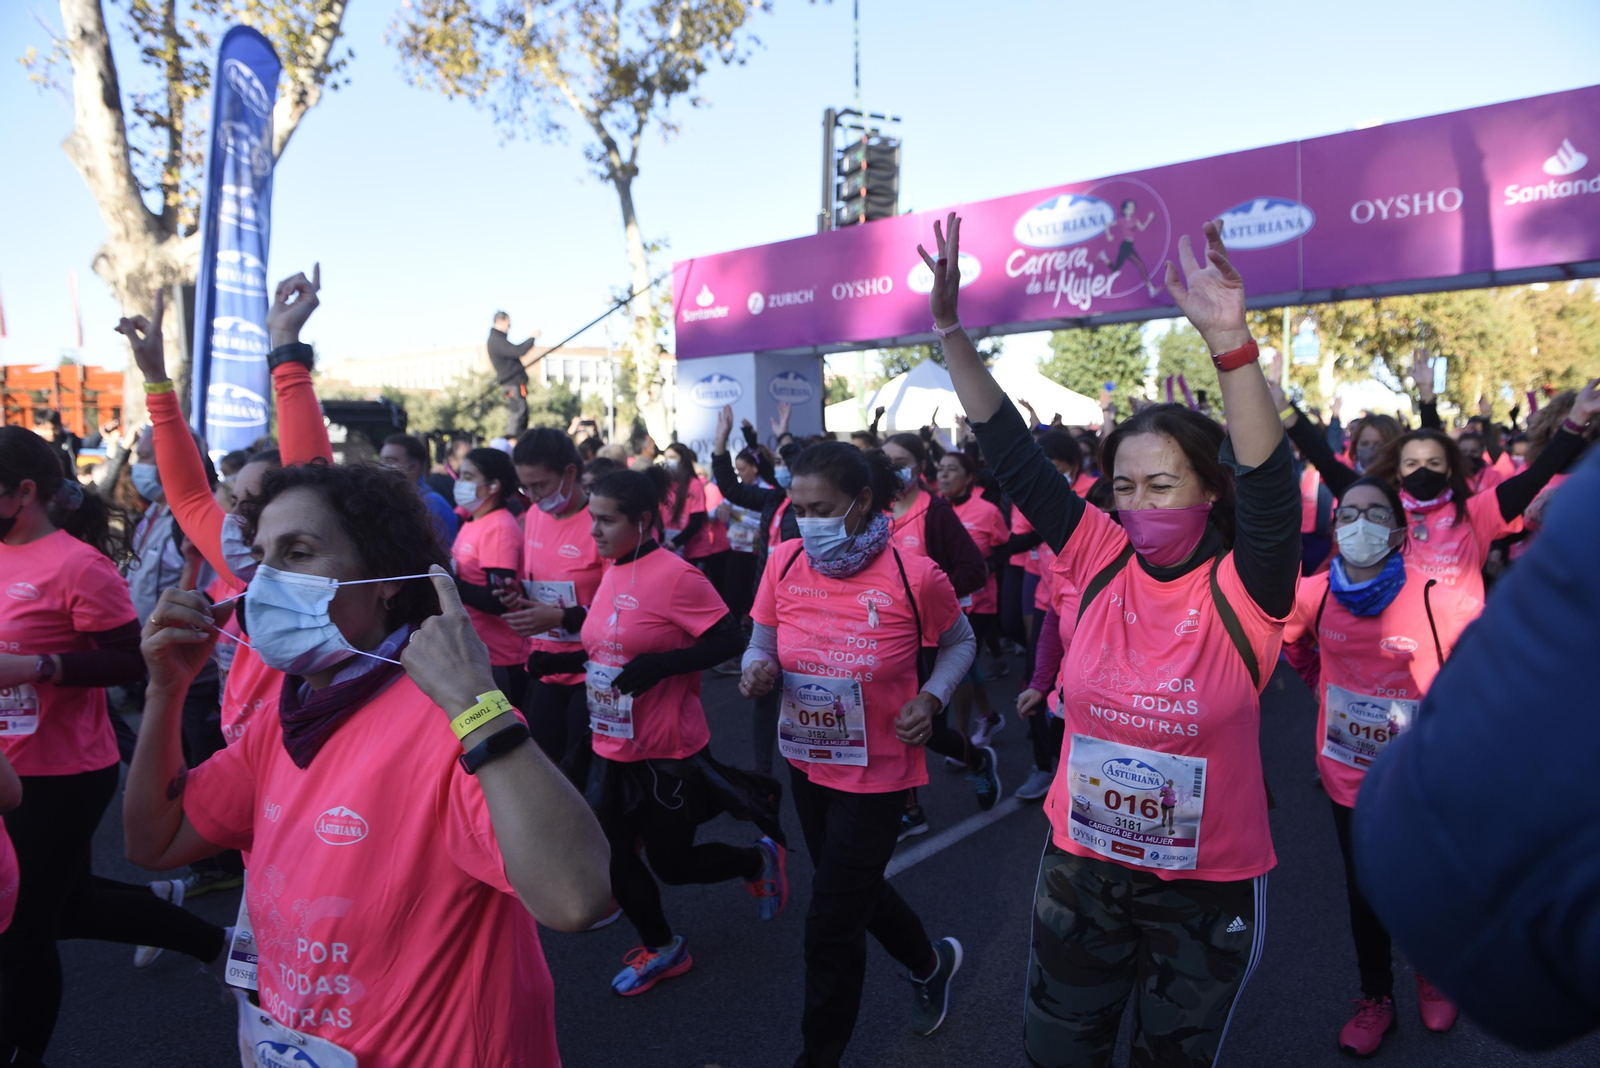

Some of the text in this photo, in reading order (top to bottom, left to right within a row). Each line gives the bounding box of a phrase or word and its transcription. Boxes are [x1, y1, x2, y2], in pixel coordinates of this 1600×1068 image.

[1351, 187, 1464, 224] OYSHO
[1023, 213, 1107, 239] ASTURIANA
[1006, 248, 1088, 278] Carrera
[832, 276, 893, 300] OYSHO
[1026, 262, 1121, 311] de la Mujer
[768, 289, 814, 309] ZURICH
[682, 305, 729, 323] Santander
[1436, 554, 1458, 564] POR
[788, 585, 828, 600] OYSHO
[847, 636, 878, 650] POR
[1318, 626, 1347, 642] YSHO
[0, 642, 20, 651] OR
[604, 640, 624, 652] POR
[828, 649, 876, 666] TODAS
[797, 660, 874, 682] NOSOTRAS
[1156, 677, 1196, 693] POR
[1377, 688, 1408, 698] POR
[798, 690, 832, 702] ASTURIANA
[1132, 694, 1198, 716] TODAS
[464, 706, 492, 725] TURNO
[798, 710, 836, 728] 016
[1090, 704, 1198, 737] NOSOTRAS
[792, 736, 813, 744] CARRERA
[808, 730, 826, 738] 3182
[1349, 722, 1388, 743] 016
[782, 744, 806, 756] OYSHO
[1106, 764, 1160, 786] ASTURIANA
[1104, 790, 1159, 819] 016
[1088, 820, 1174, 845] CARRERA DE LA MUJER
[1115, 816, 1141, 832] 3181
[1073, 826, 1106, 848] OYSHO
[1120, 846, 1141, 855] Santander
[297, 938, 348, 964] POR
[229, 967, 258, 982] OYSHO
[279, 962, 350, 996] TODAS
[263, 987, 352, 1029] OSOTRAS
